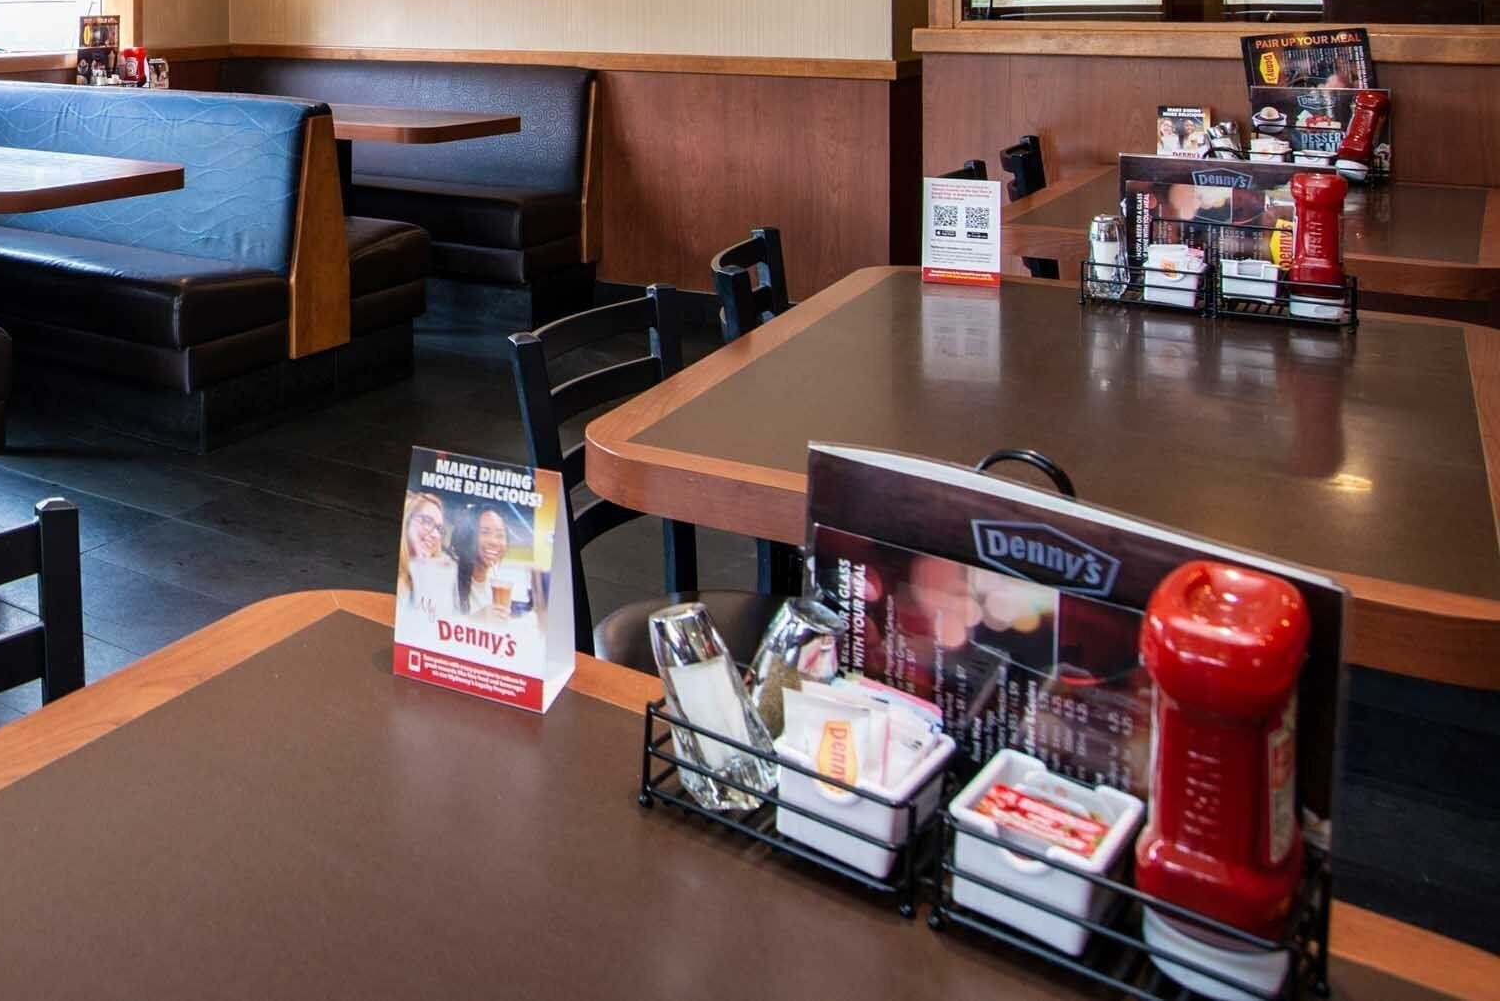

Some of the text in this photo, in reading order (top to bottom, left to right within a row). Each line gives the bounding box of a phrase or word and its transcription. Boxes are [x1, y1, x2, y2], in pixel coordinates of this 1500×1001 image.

[1255, 32, 1361, 50] PAIR UP YOUR MEAL
[1198, 174, 1247, 188] Denny's
[421, 472, 543, 508] MORE DELICIOUS!
[436, 459, 533, 490] MAKE DINING
[985, 528, 1102, 585] Denny's
[838, 558, 851, 599] GLASS
[839, 600, 850, 611] A
[853, 564, 866, 668] WITH YOUR MEAL
[437, 619, 517, 657] Denny's
